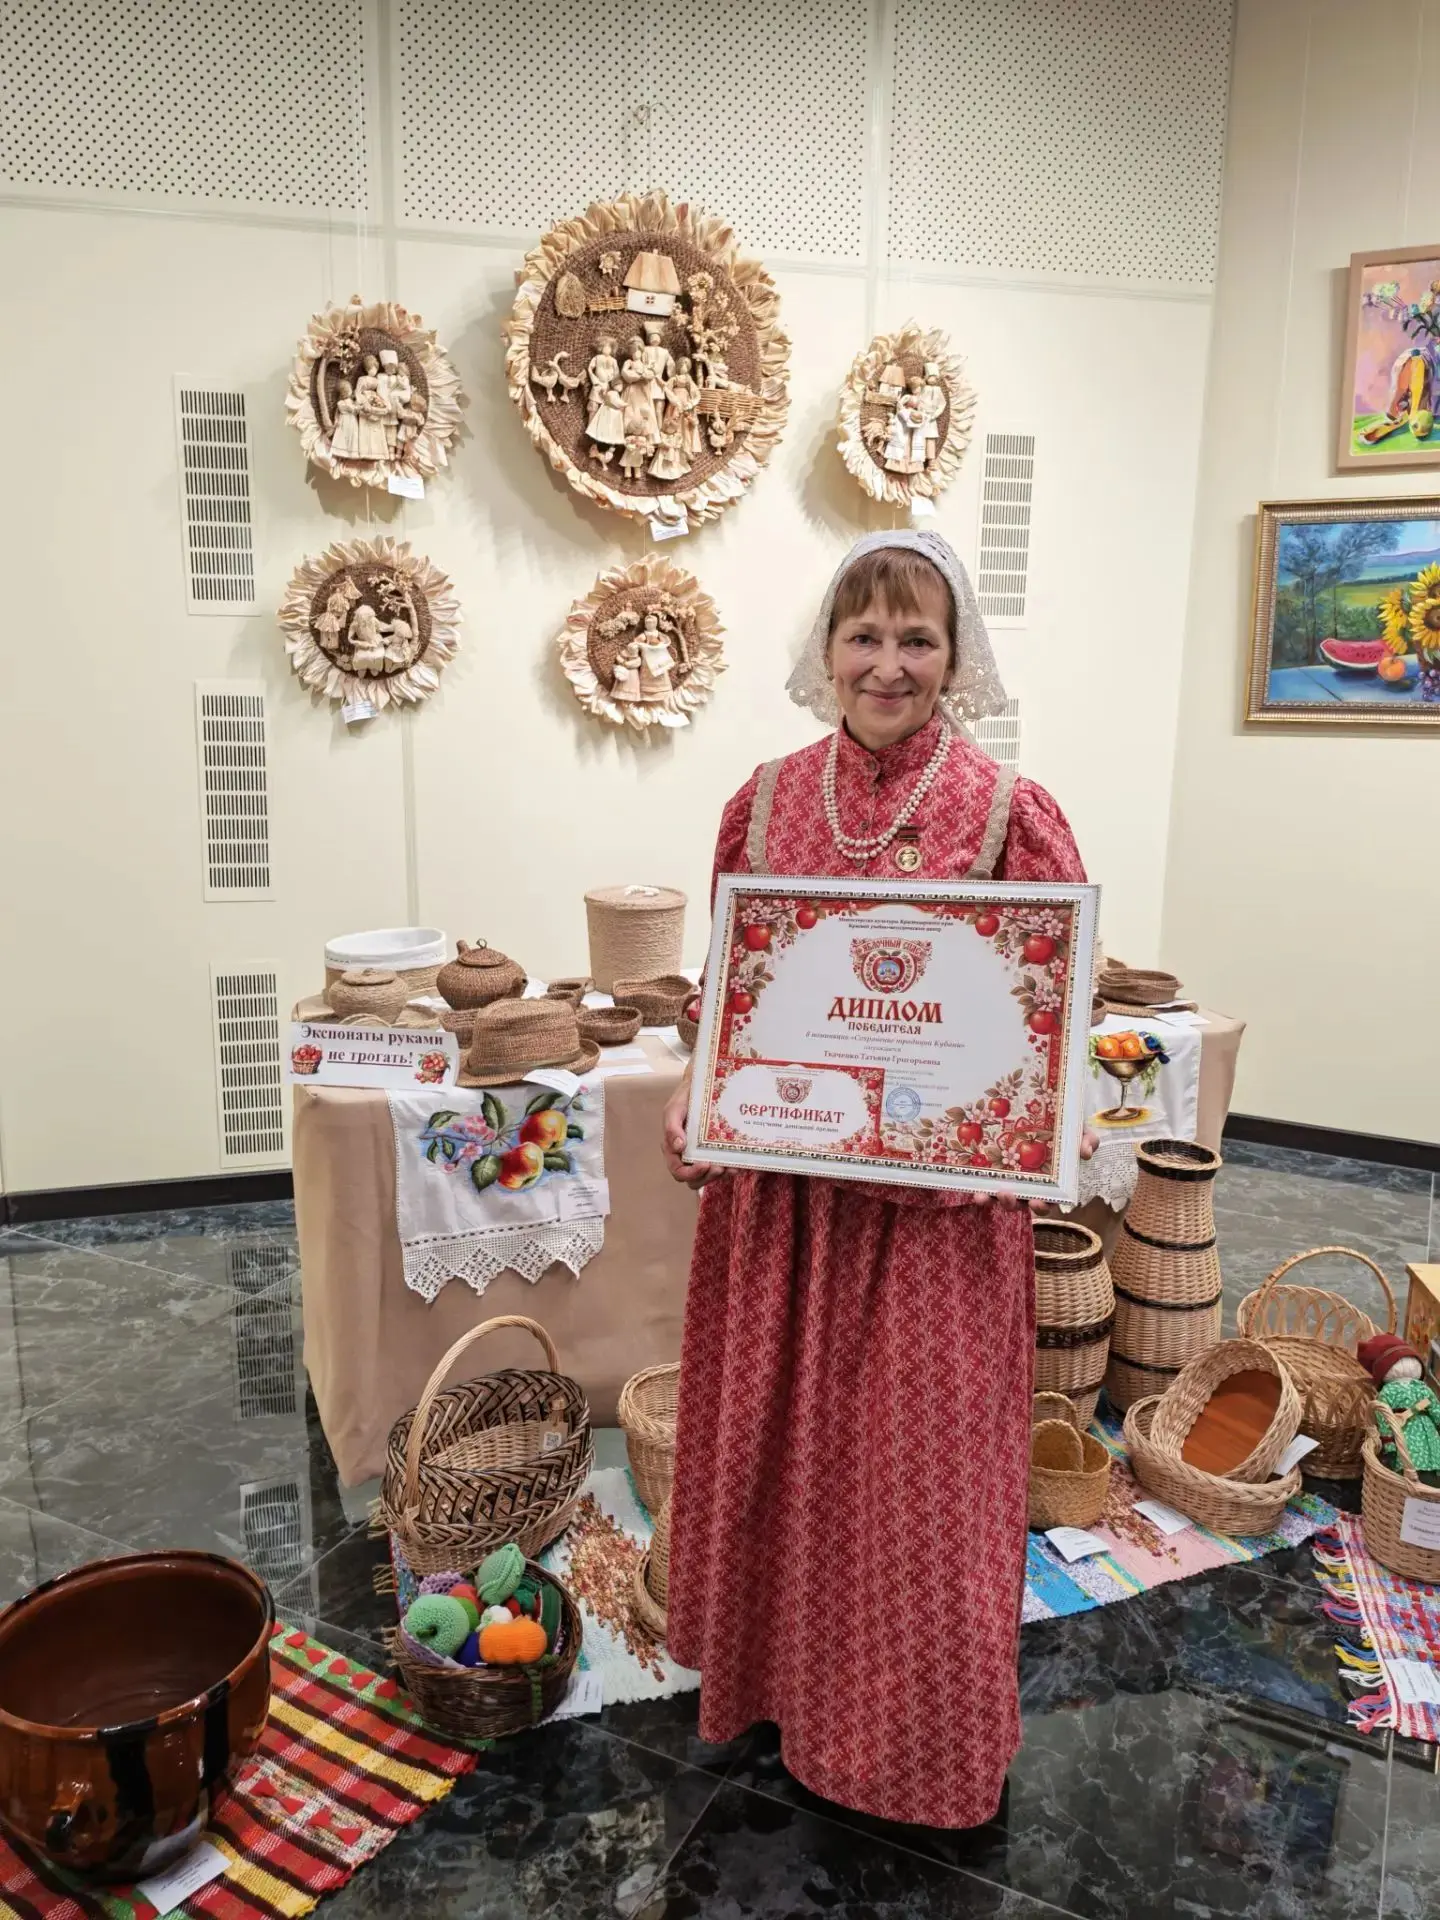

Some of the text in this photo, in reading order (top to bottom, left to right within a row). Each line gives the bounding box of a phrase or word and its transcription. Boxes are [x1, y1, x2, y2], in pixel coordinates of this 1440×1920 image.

[827, 996, 943, 1023] ДИПЛОМ
[301, 1024, 443, 1046] Экспонаты руками
[848, 1021, 921, 1035] ПОБЕДИТЕЛЯ
[328, 1049, 413, 1064] не трогать!
[824, 1050, 941, 1066] Ткаченко Татьяна Григорьевна
[739, 1103, 845, 1124] СЕРТИФИКАТ
